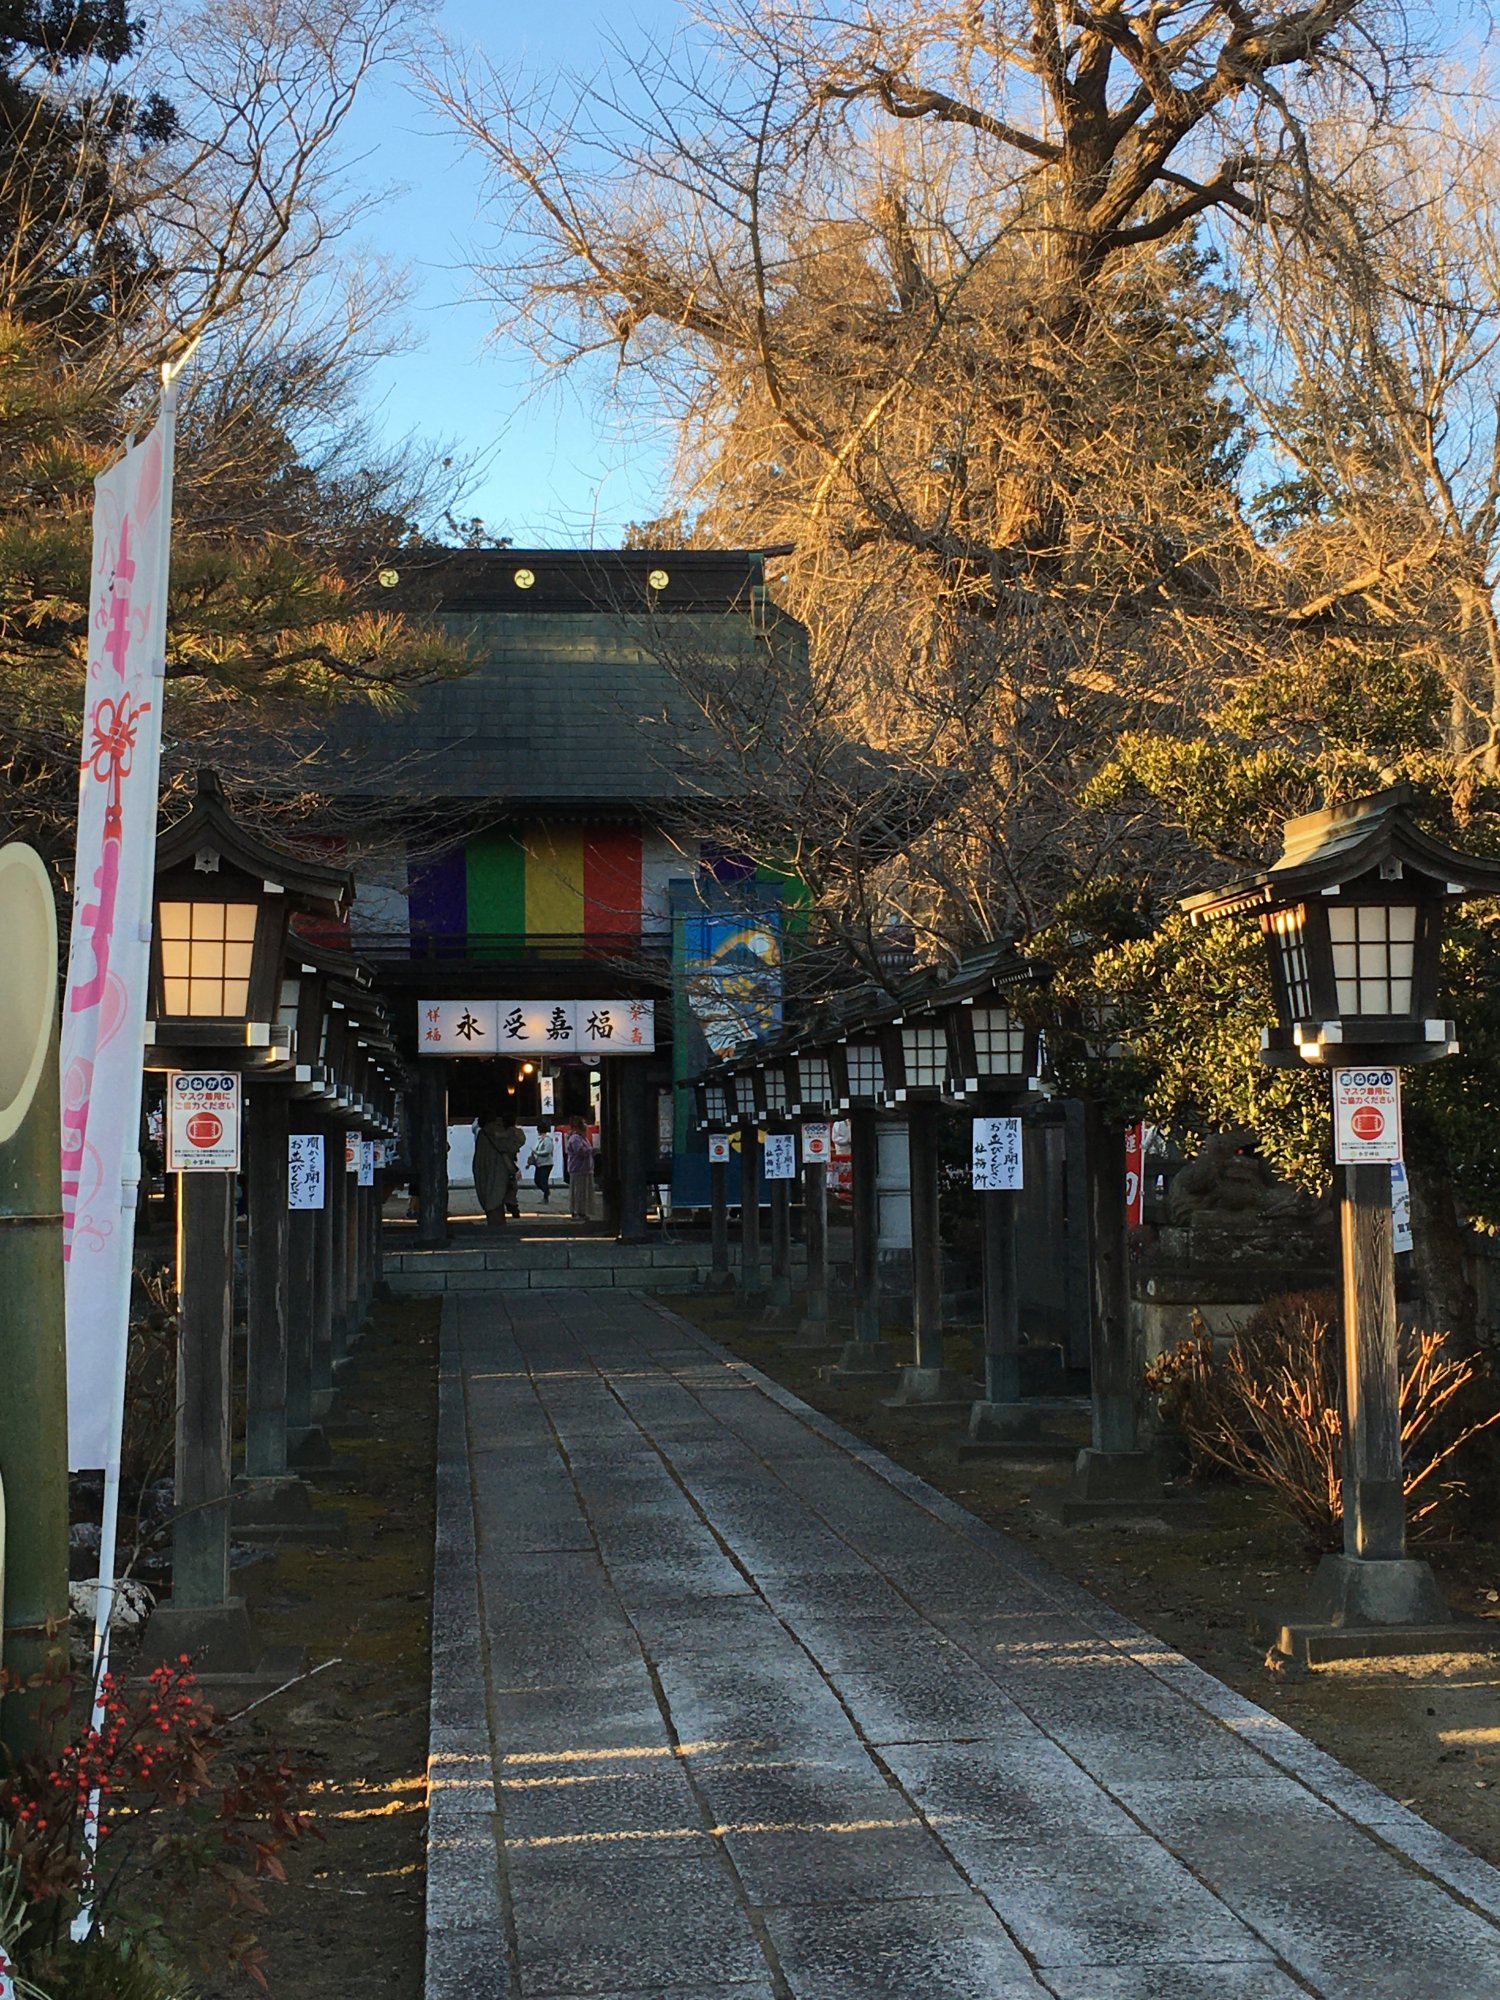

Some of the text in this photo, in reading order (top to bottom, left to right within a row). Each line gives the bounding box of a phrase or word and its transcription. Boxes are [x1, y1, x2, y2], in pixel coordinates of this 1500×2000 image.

[455, 1006, 614, 1041] 永受嘉福
[176, 1078, 234, 1090] おねがい
